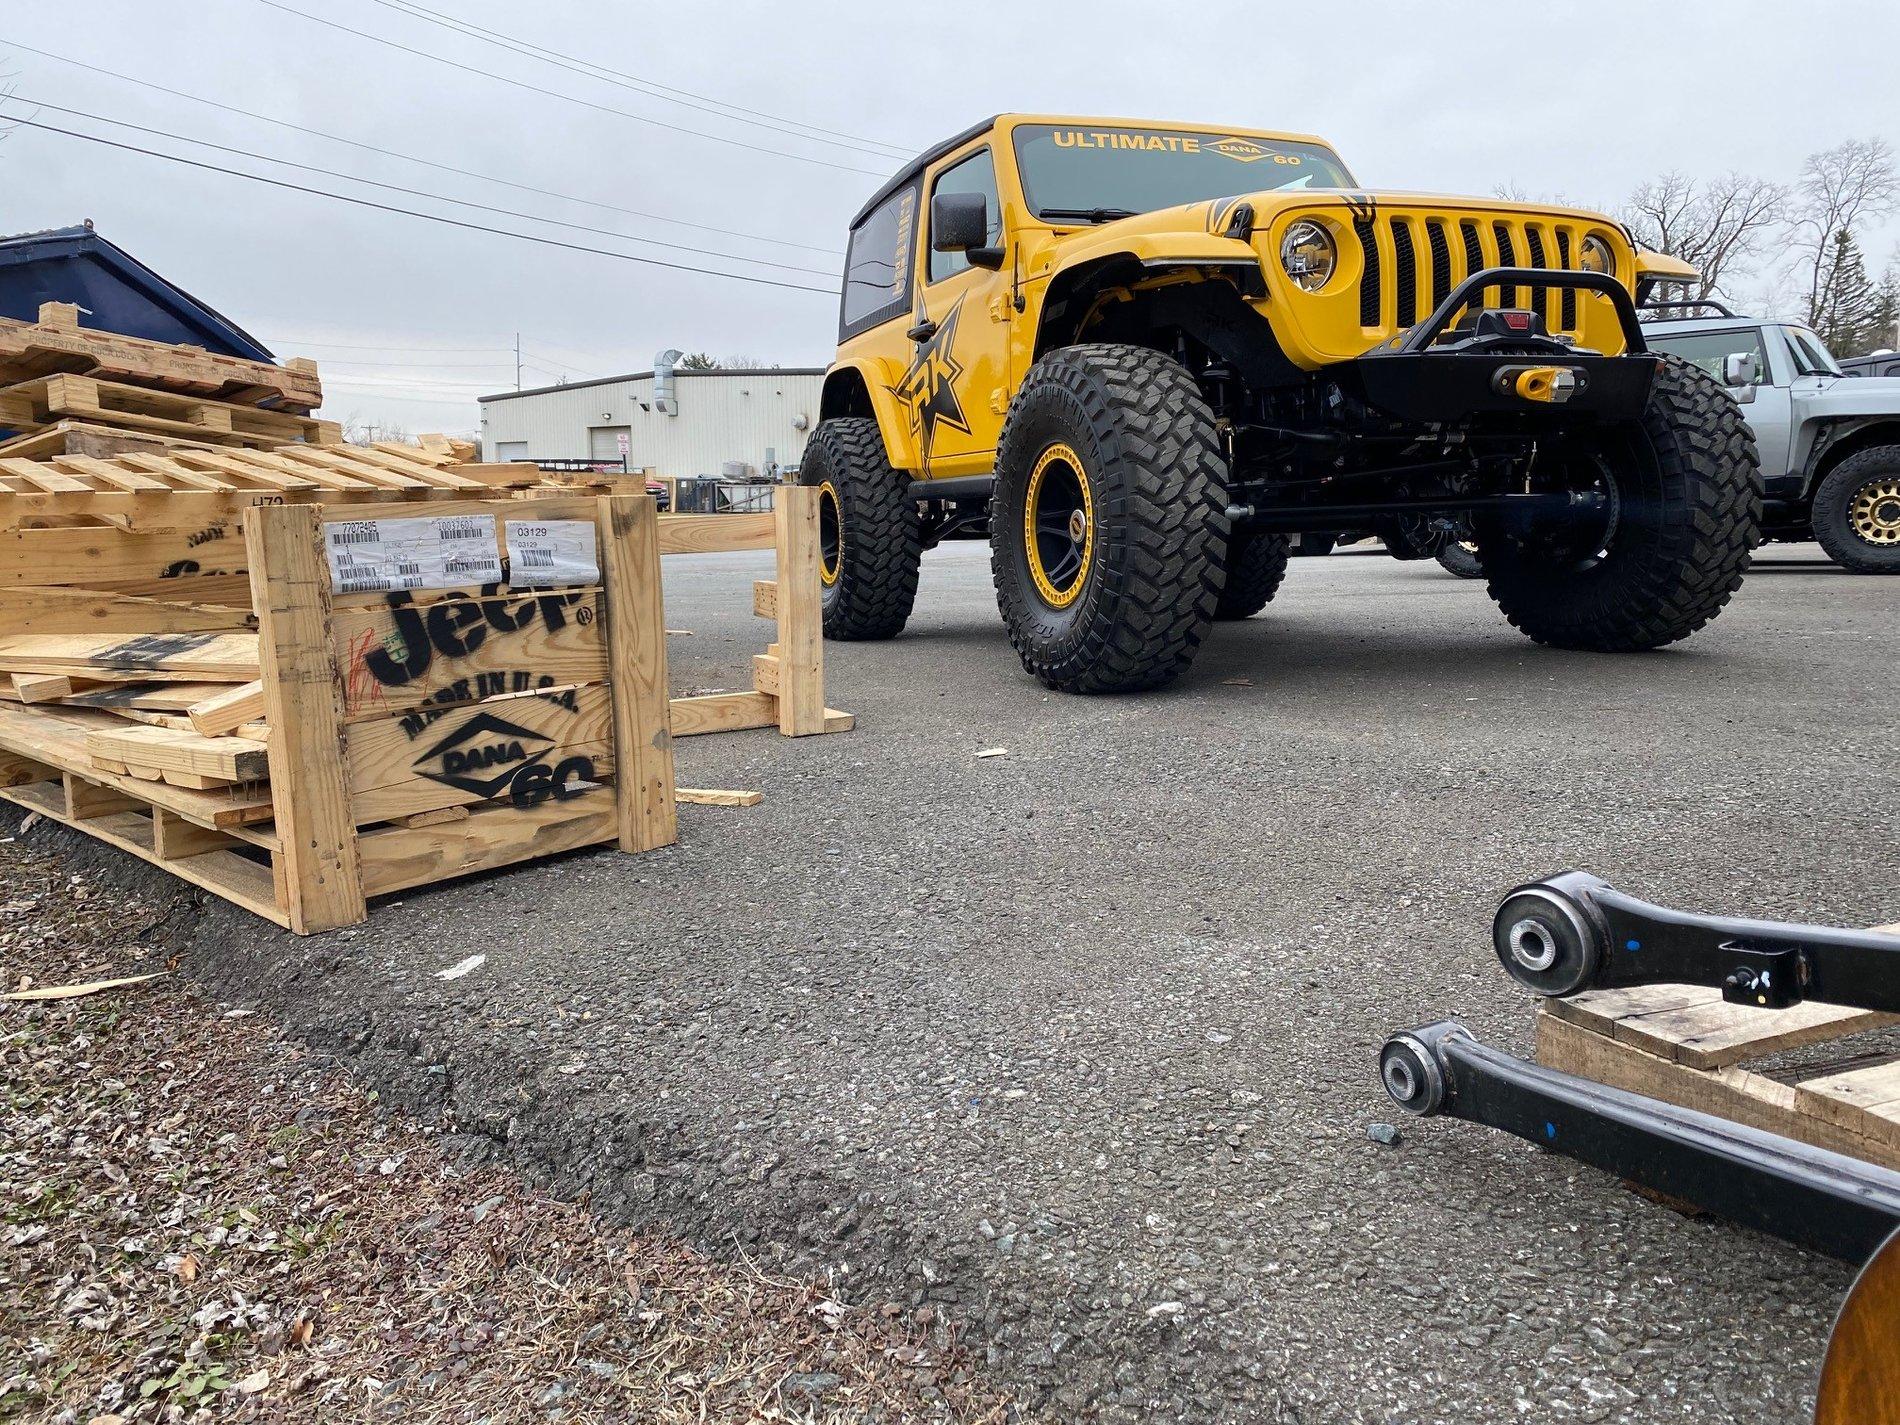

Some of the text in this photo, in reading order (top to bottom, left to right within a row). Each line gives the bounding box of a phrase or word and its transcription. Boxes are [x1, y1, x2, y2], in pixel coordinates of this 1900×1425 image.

[1053, 131, 1301, 166] ULTIMATE DANA 60
[517, 527, 547, 537] 03129
[475, 671, 506, 699] IN
[513, 671, 578, 713] US.A.
[442, 740, 527, 775] DANA
[510, 756, 595, 810] 60
